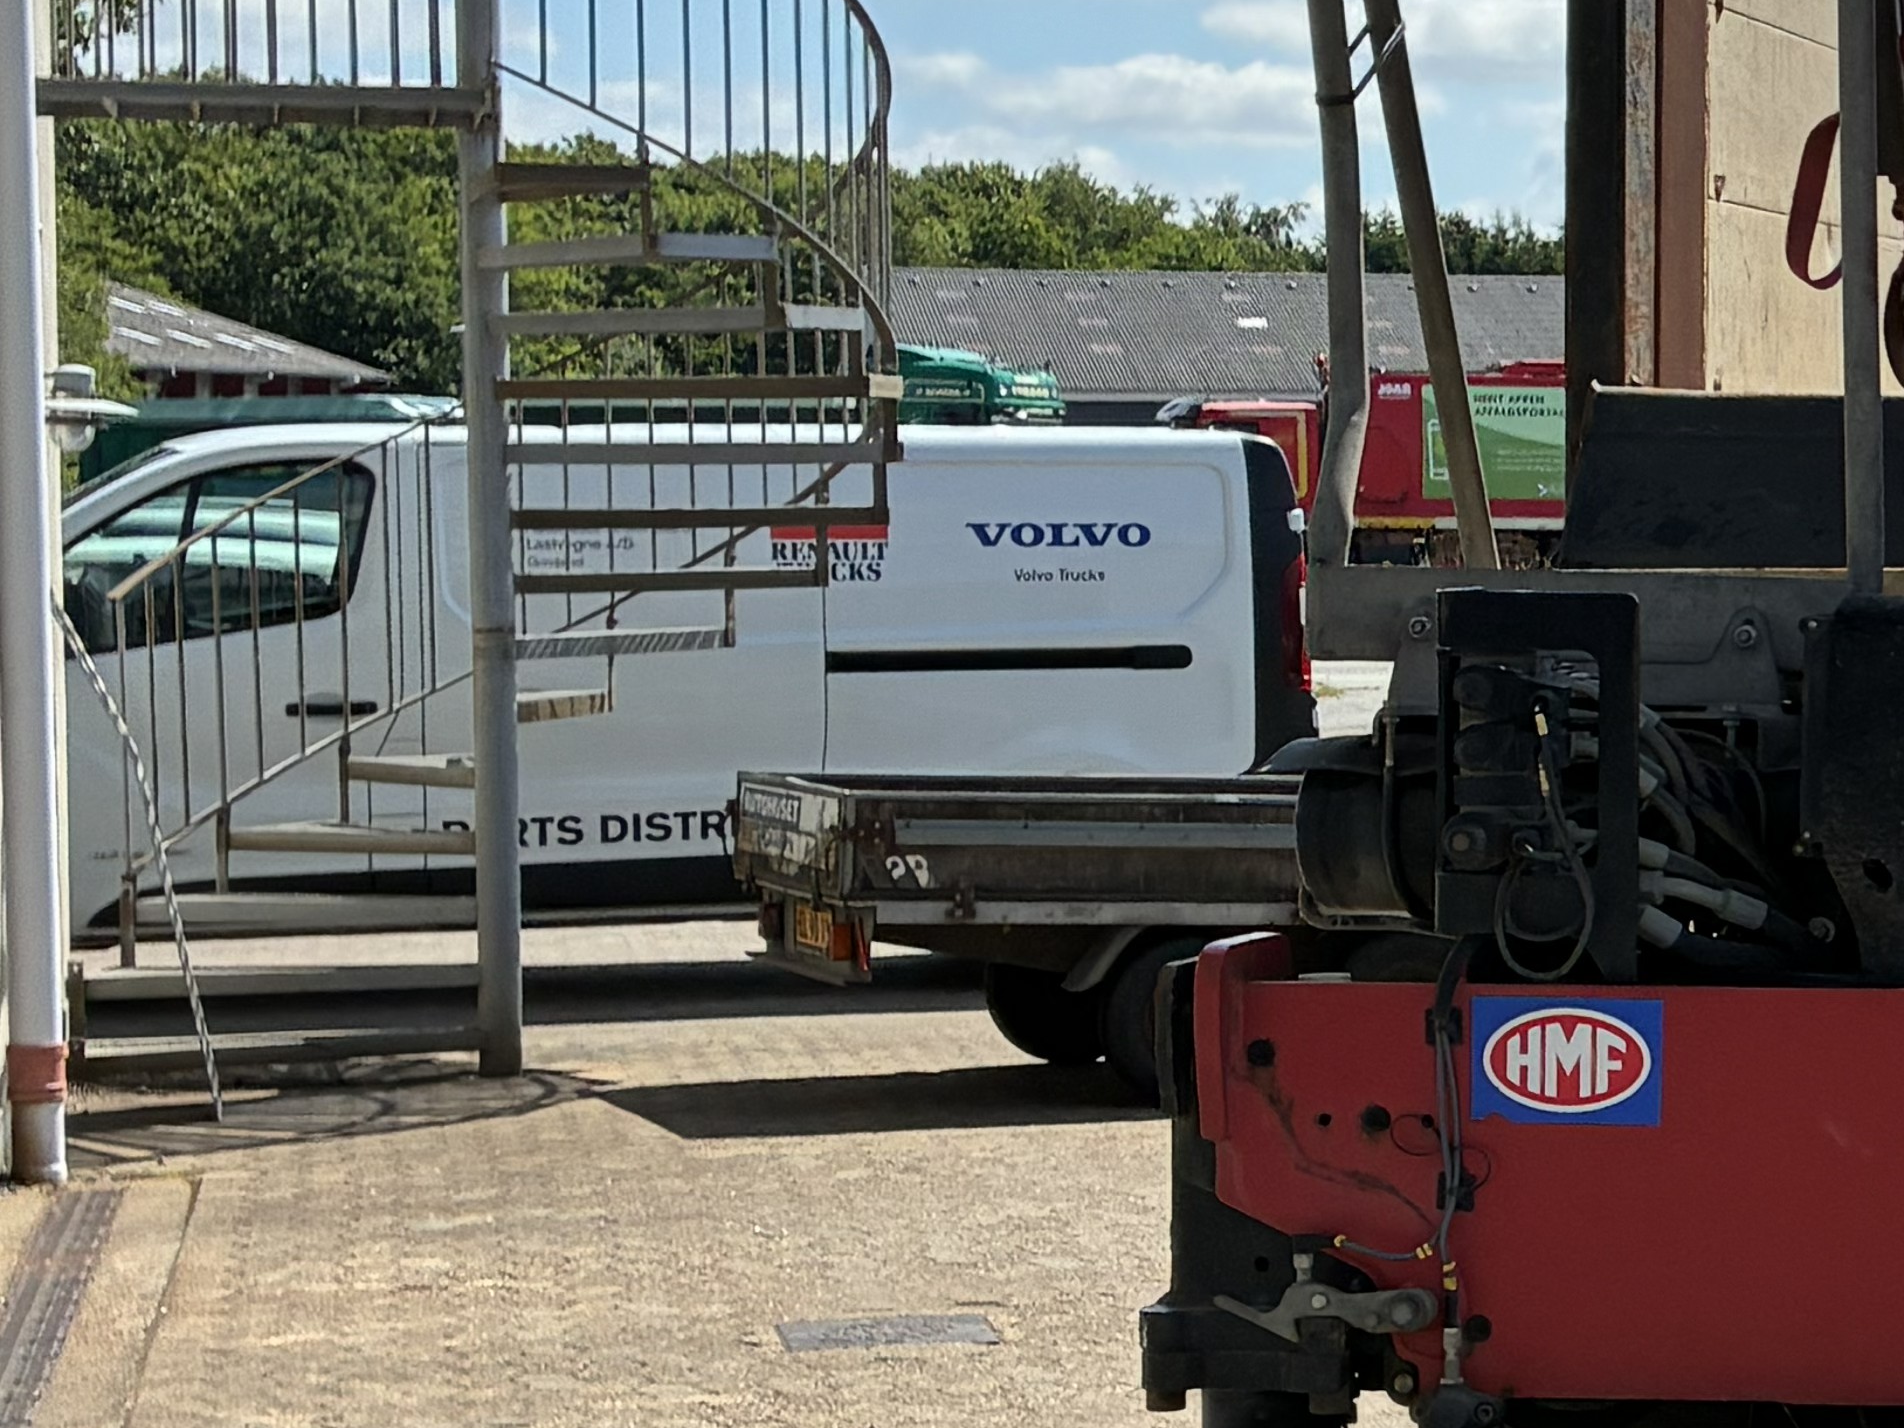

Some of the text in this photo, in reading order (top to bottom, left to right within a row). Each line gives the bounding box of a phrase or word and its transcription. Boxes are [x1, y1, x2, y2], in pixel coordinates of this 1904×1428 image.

[965, 522, 1151, 547] VOLVO
[776, 562, 882, 581] CKS
[1014, 568, 1053, 582] Volvo
[443, 811, 738, 847] RTS DISTR
[1506, 1023, 1627, 1098] HMF
